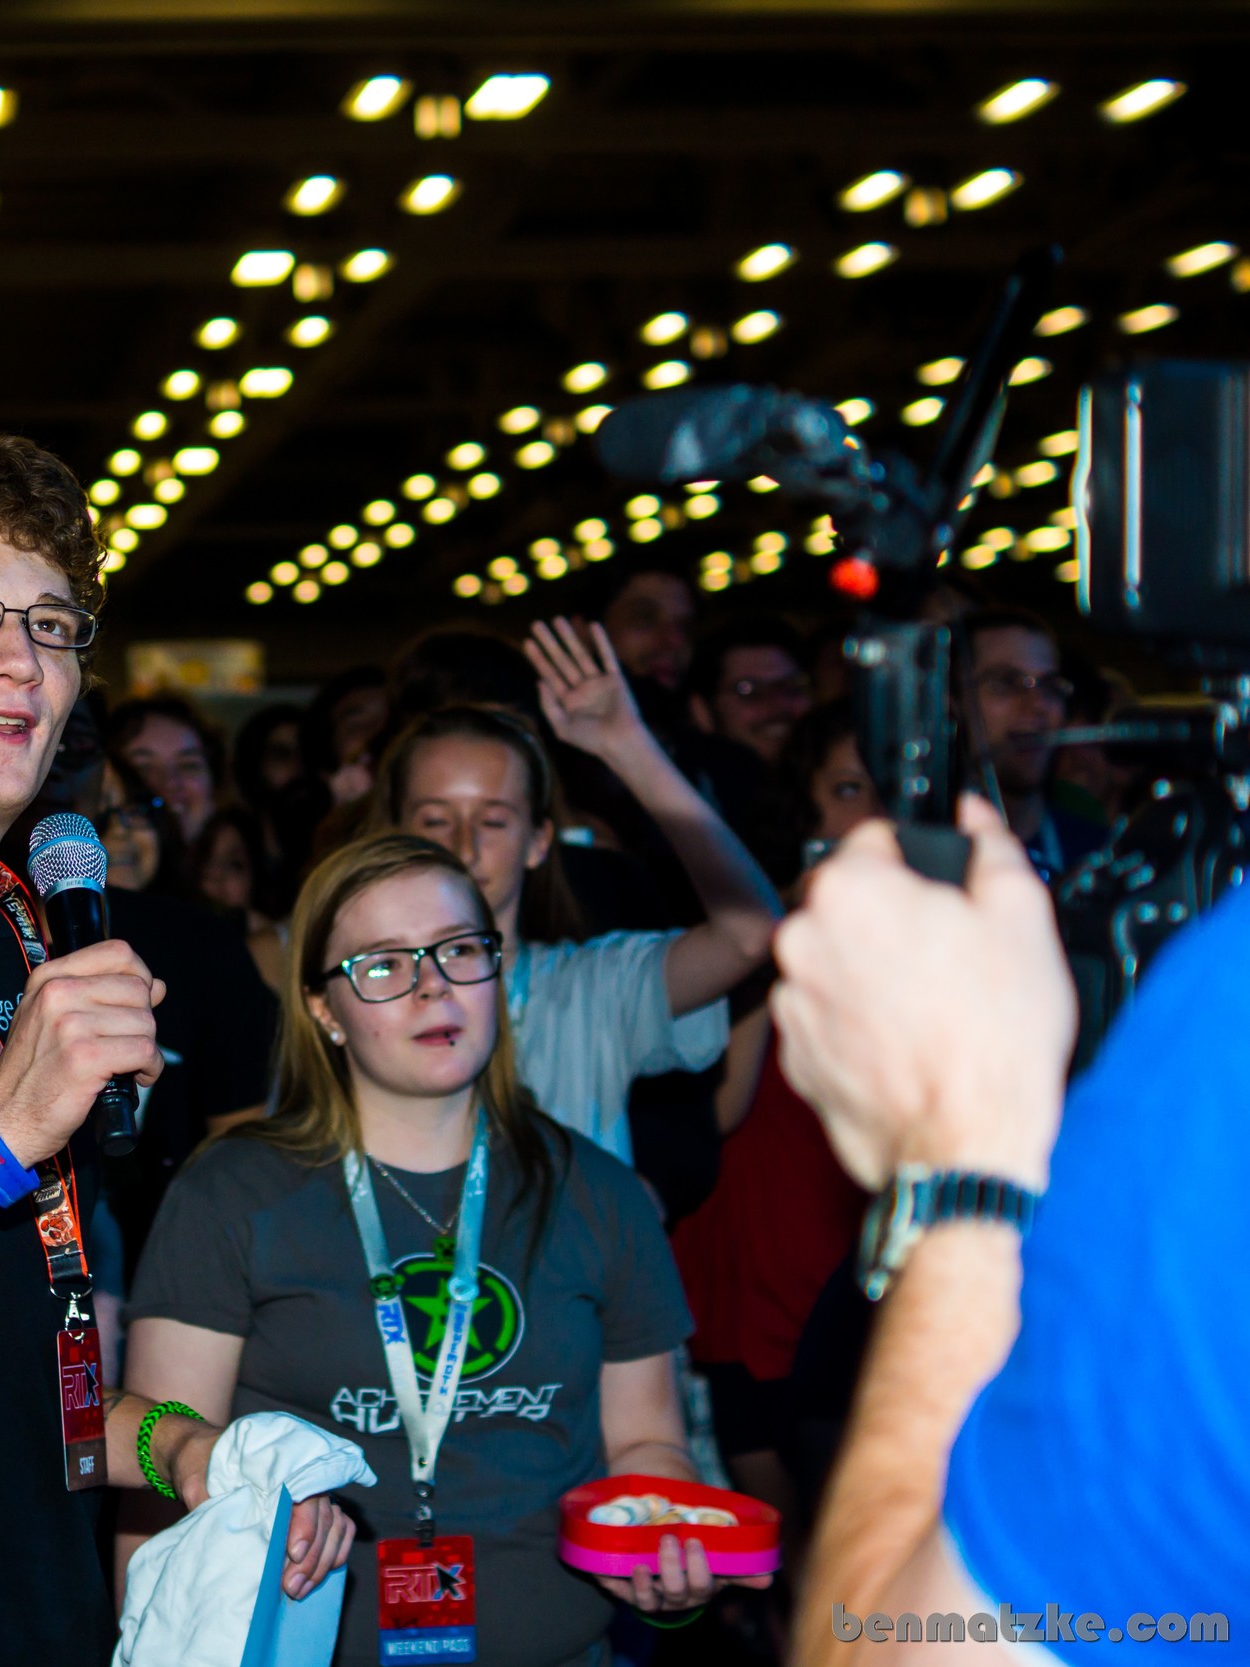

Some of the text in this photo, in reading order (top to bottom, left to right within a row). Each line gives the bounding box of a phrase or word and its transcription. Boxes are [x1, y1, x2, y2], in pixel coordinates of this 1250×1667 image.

[66, 880, 82, 888] BETA
[378, 1302, 406, 1345] RTX
[62, 1360, 99, 1411] RTX
[331, 1383, 564, 1409] ACHEMENT
[79, 1455, 95, 1476] STAFF
[383, 1562, 467, 1604] RTX
